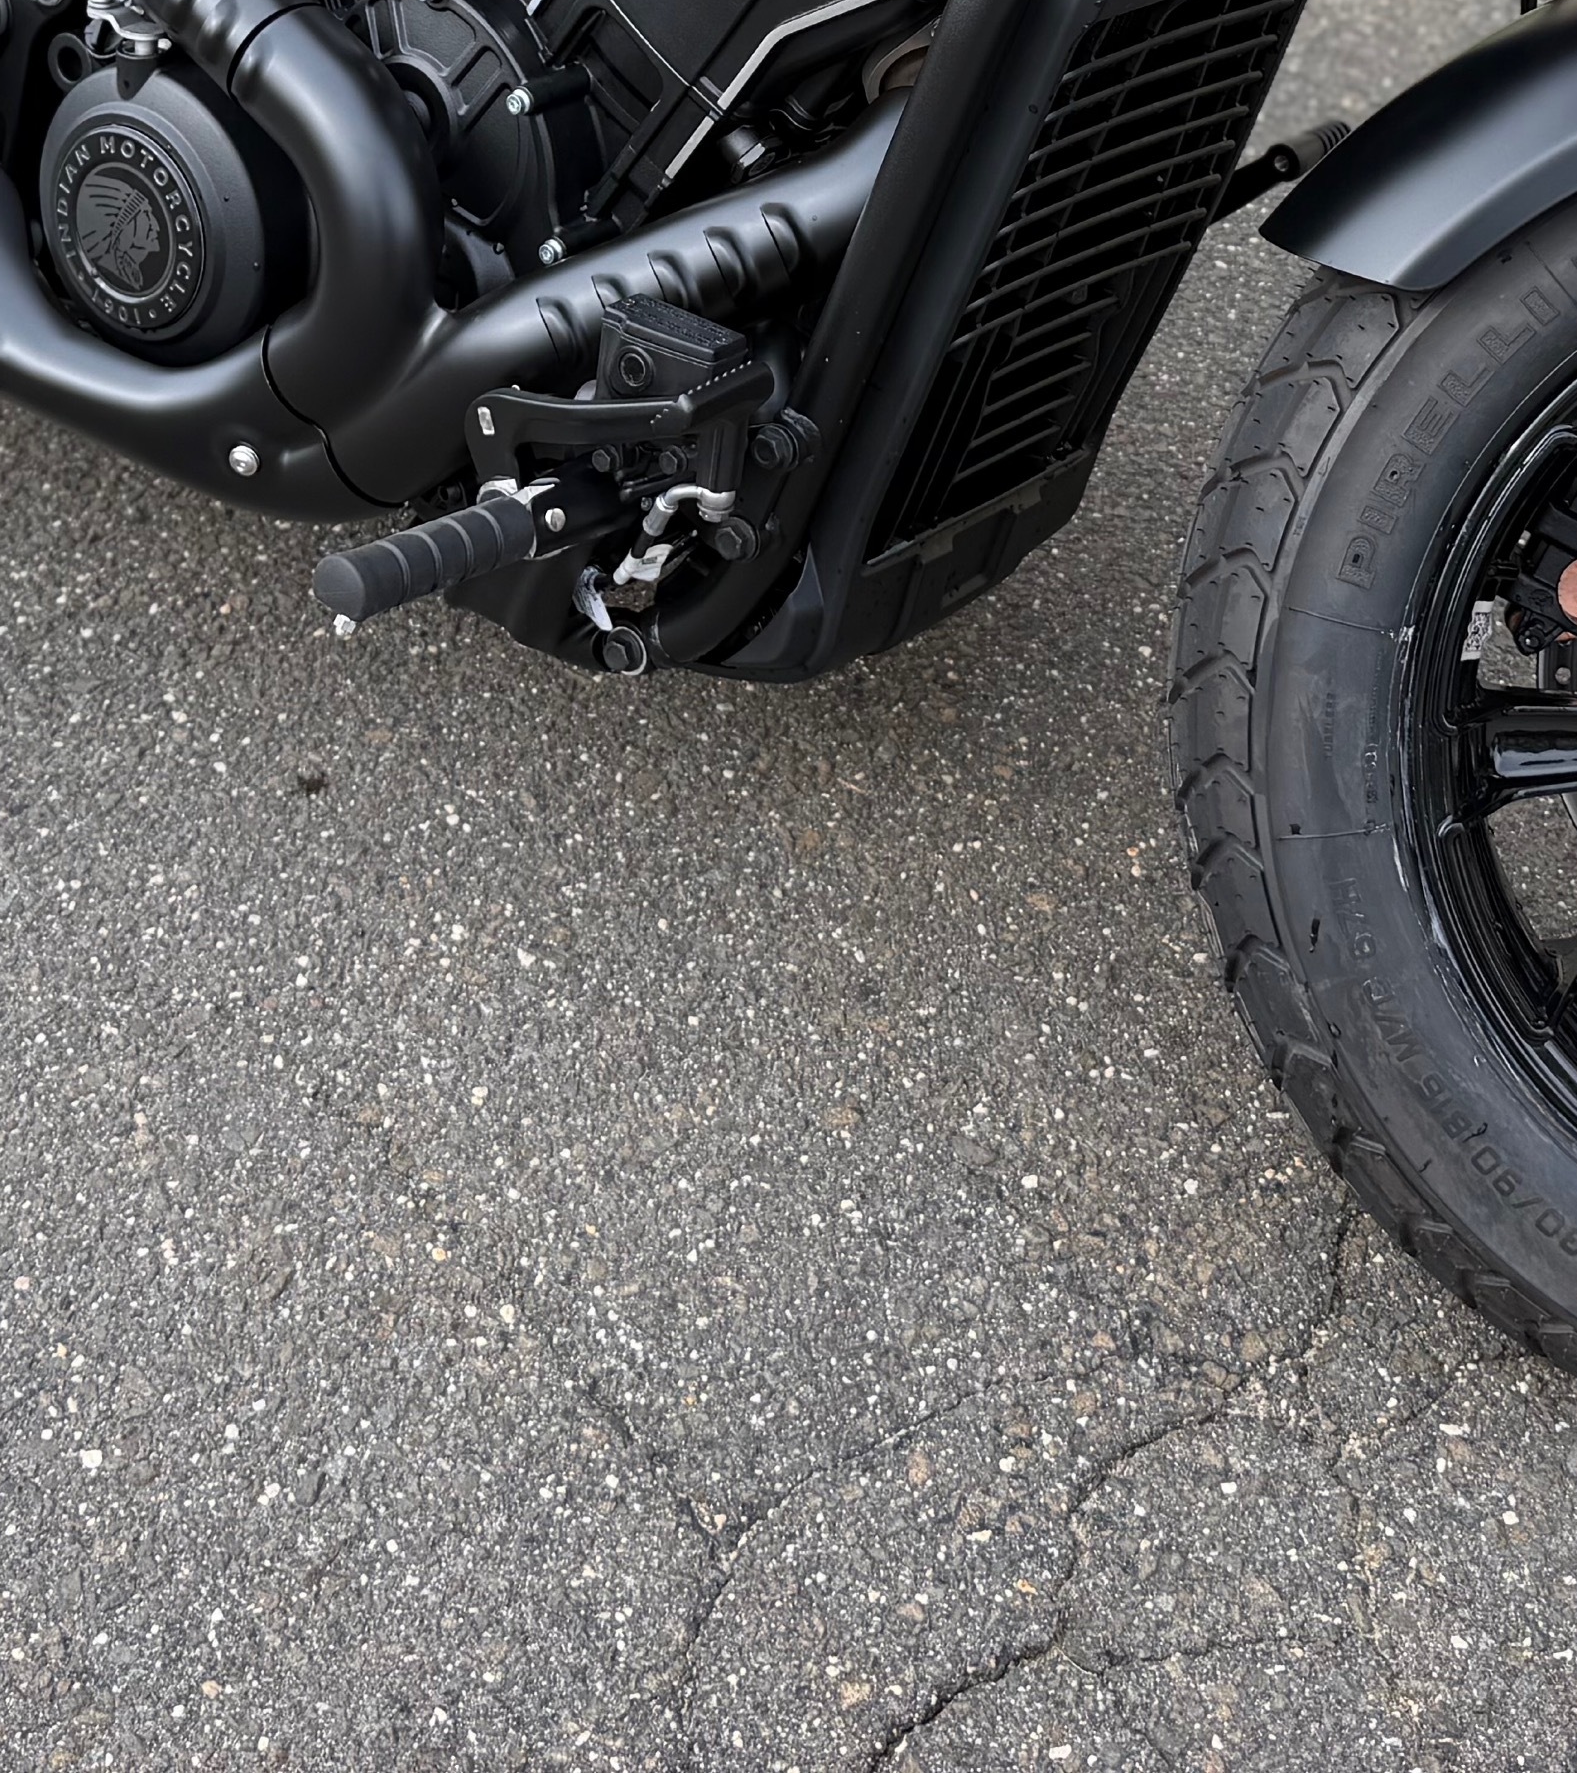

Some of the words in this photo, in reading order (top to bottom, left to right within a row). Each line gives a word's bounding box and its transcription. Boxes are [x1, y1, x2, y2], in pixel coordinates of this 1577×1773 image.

[57, 143, 91, 260] INDIAN
[99, 134, 194, 313] MOTORCYCLE
[1338, 287, 1560, 590] PIRELLI
